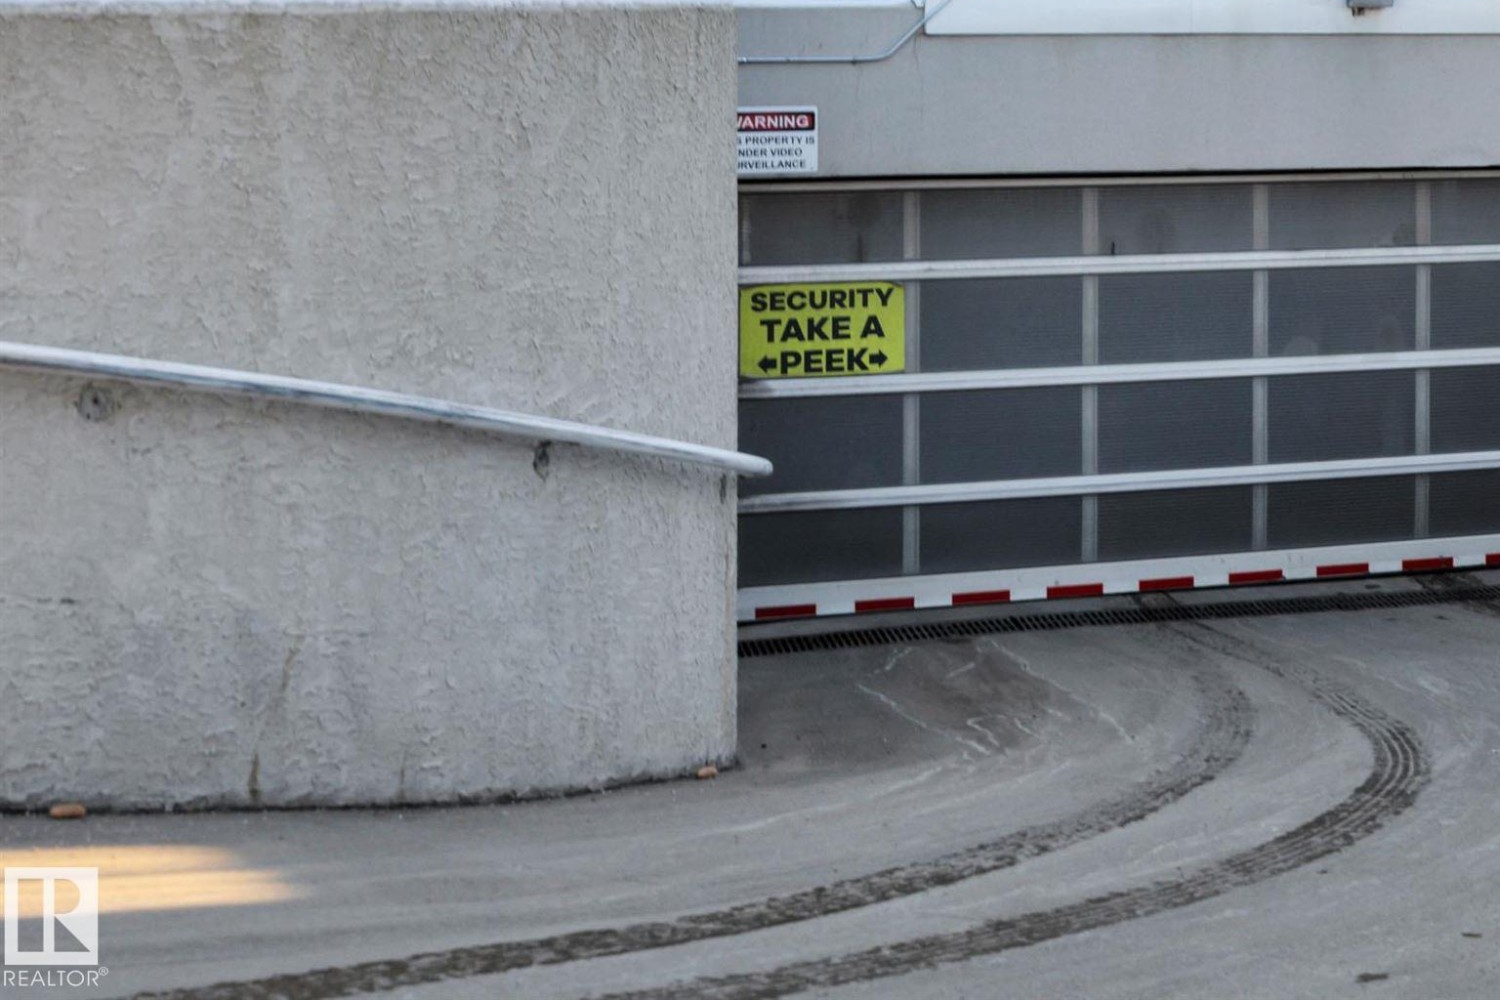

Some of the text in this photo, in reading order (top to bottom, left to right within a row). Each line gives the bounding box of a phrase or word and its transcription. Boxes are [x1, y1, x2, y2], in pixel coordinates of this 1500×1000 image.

[745, 136, 802, 145] PROPERTY
[805, 136, 815, 144] IS
[738, 147, 803, 157] NDER VIDEO
[737, 160, 806, 169] RVEILLANCE
[751, 287, 894, 312] SECURITY
[759, 314, 885, 343] TAKE A
[780, 347, 869, 375] PEEK
